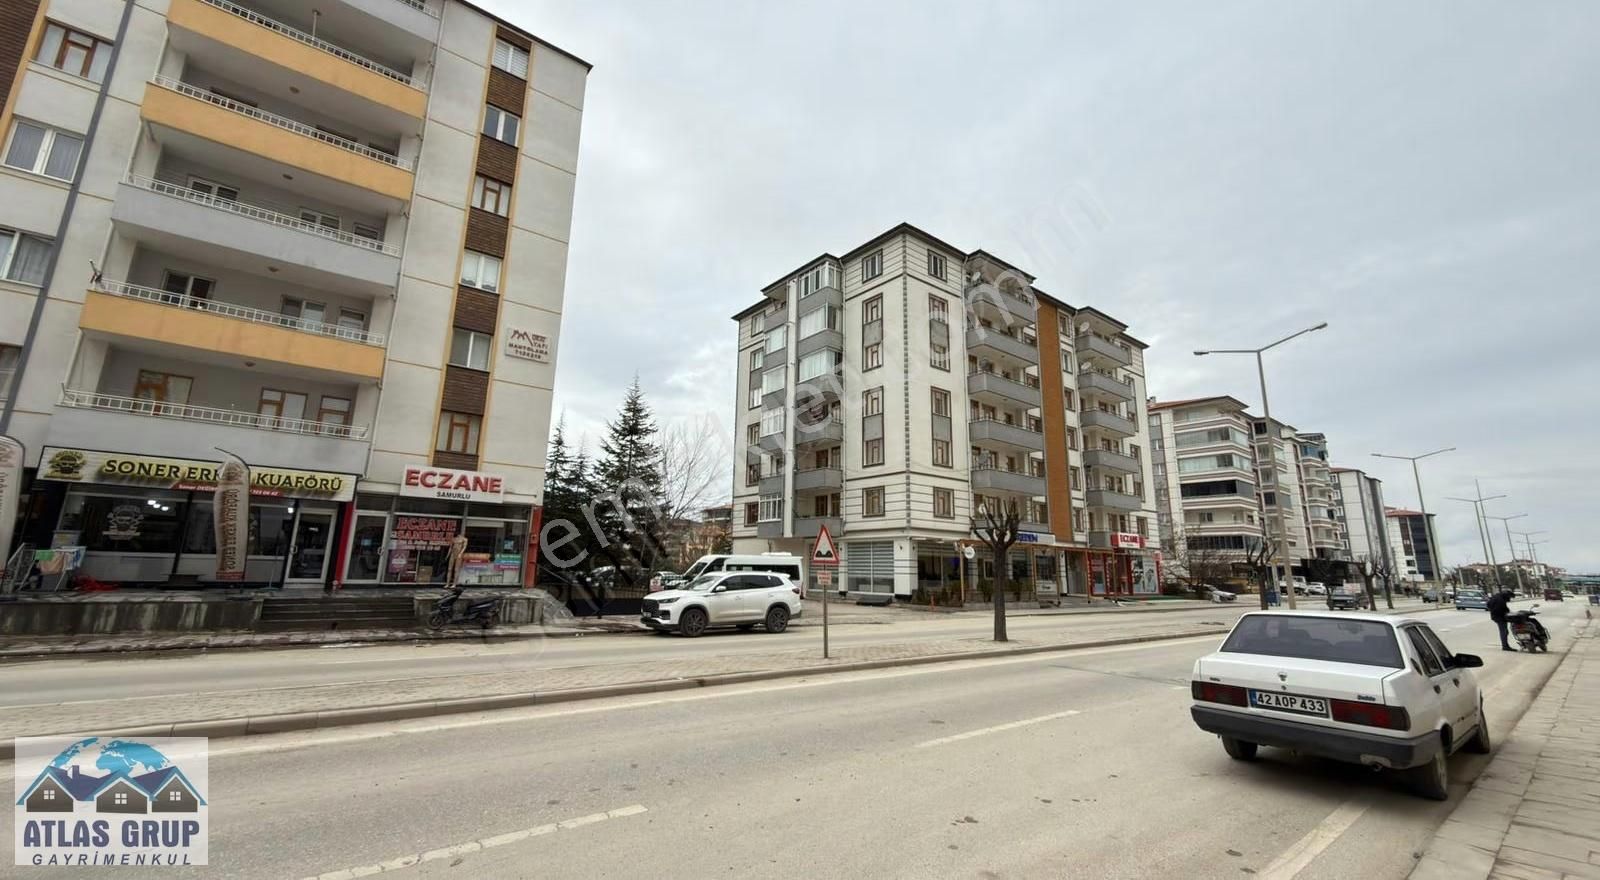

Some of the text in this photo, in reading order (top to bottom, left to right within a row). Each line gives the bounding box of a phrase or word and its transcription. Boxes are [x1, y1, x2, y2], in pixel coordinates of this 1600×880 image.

[104, 459, 181, 479] SONER
[255, 472, 343, 491] KUAFÖRÜ
[405, 469, 502, 493] ECZANE
[436, 491, 471, 500] SAMURLU
[397, 517, 457, 531] ECZANE
[1257, 693, 1325, 712] 42 AOP 433
